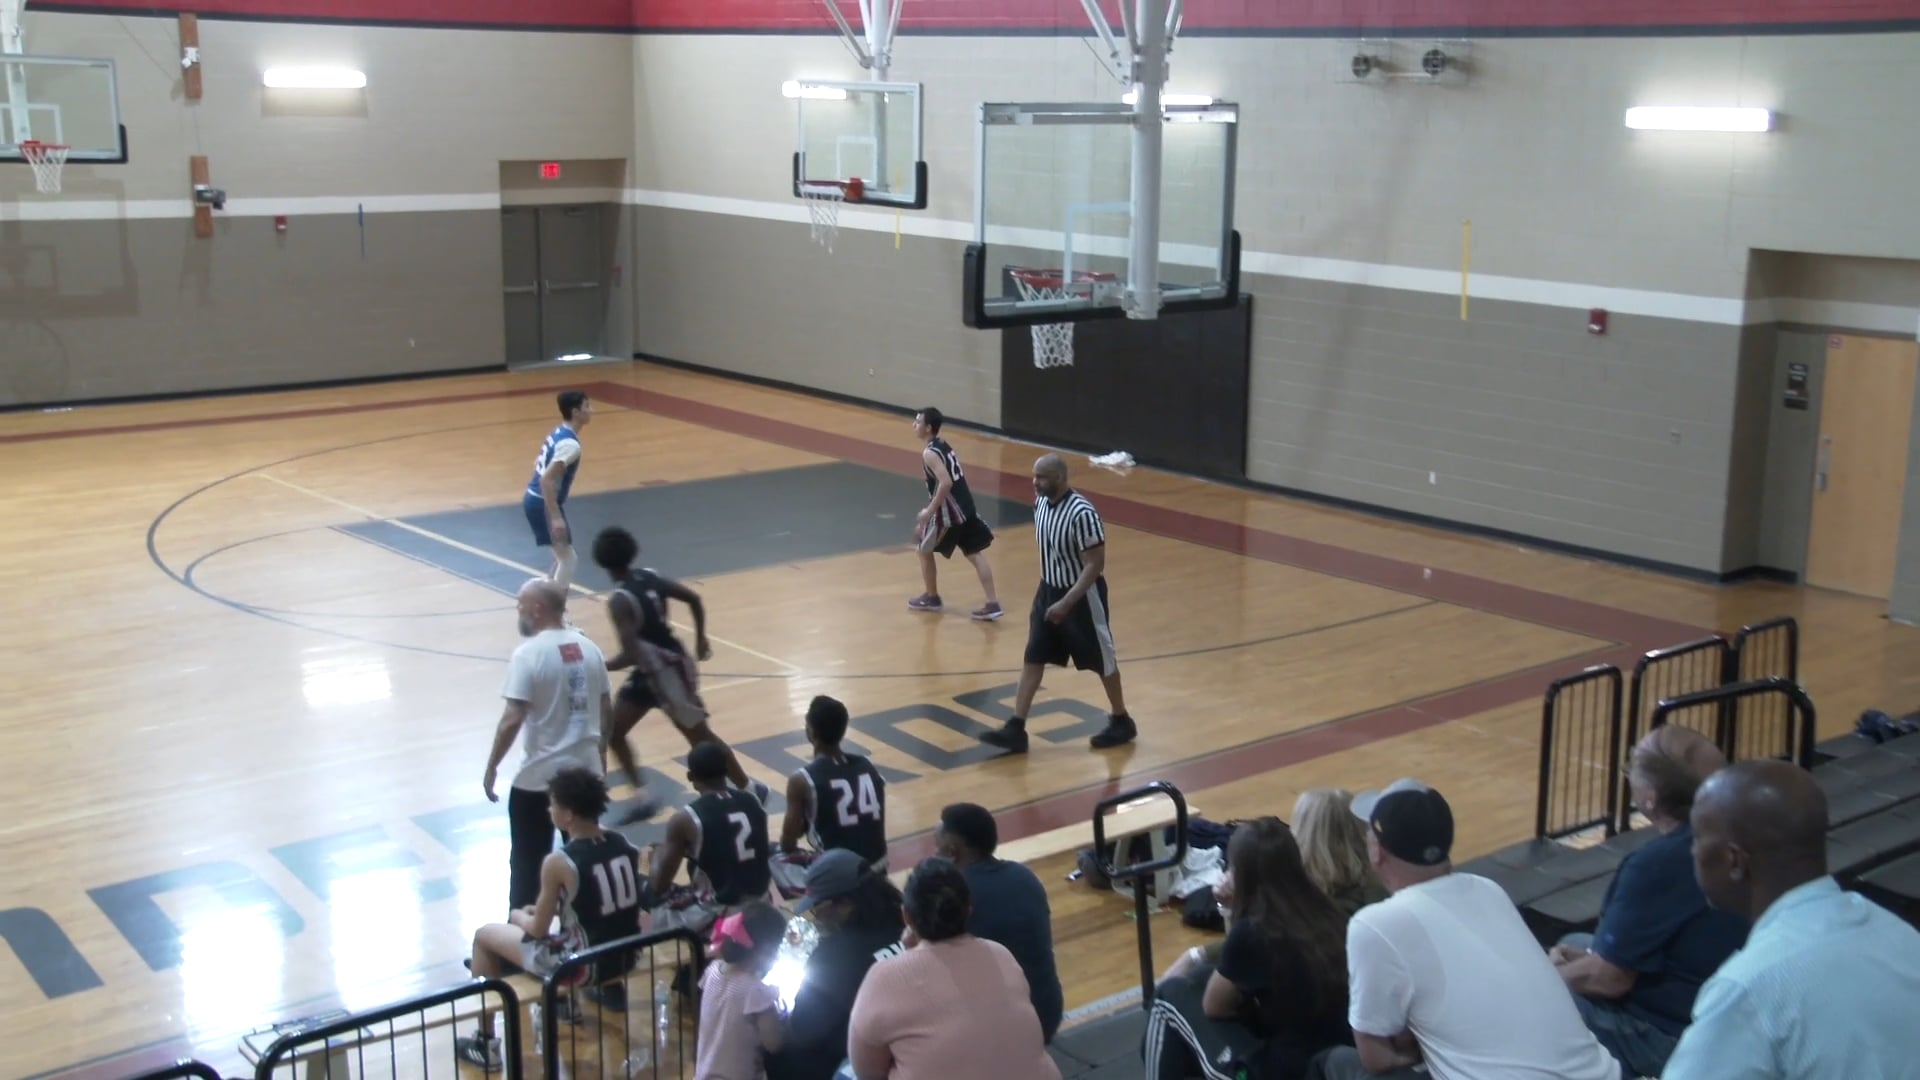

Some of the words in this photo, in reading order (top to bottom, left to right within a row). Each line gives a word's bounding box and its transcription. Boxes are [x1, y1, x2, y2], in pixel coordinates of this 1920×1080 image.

[829, 772, 881, 827] 24
[728, 811, 756, 862] 2
[593, 854, 637, 916] 10
